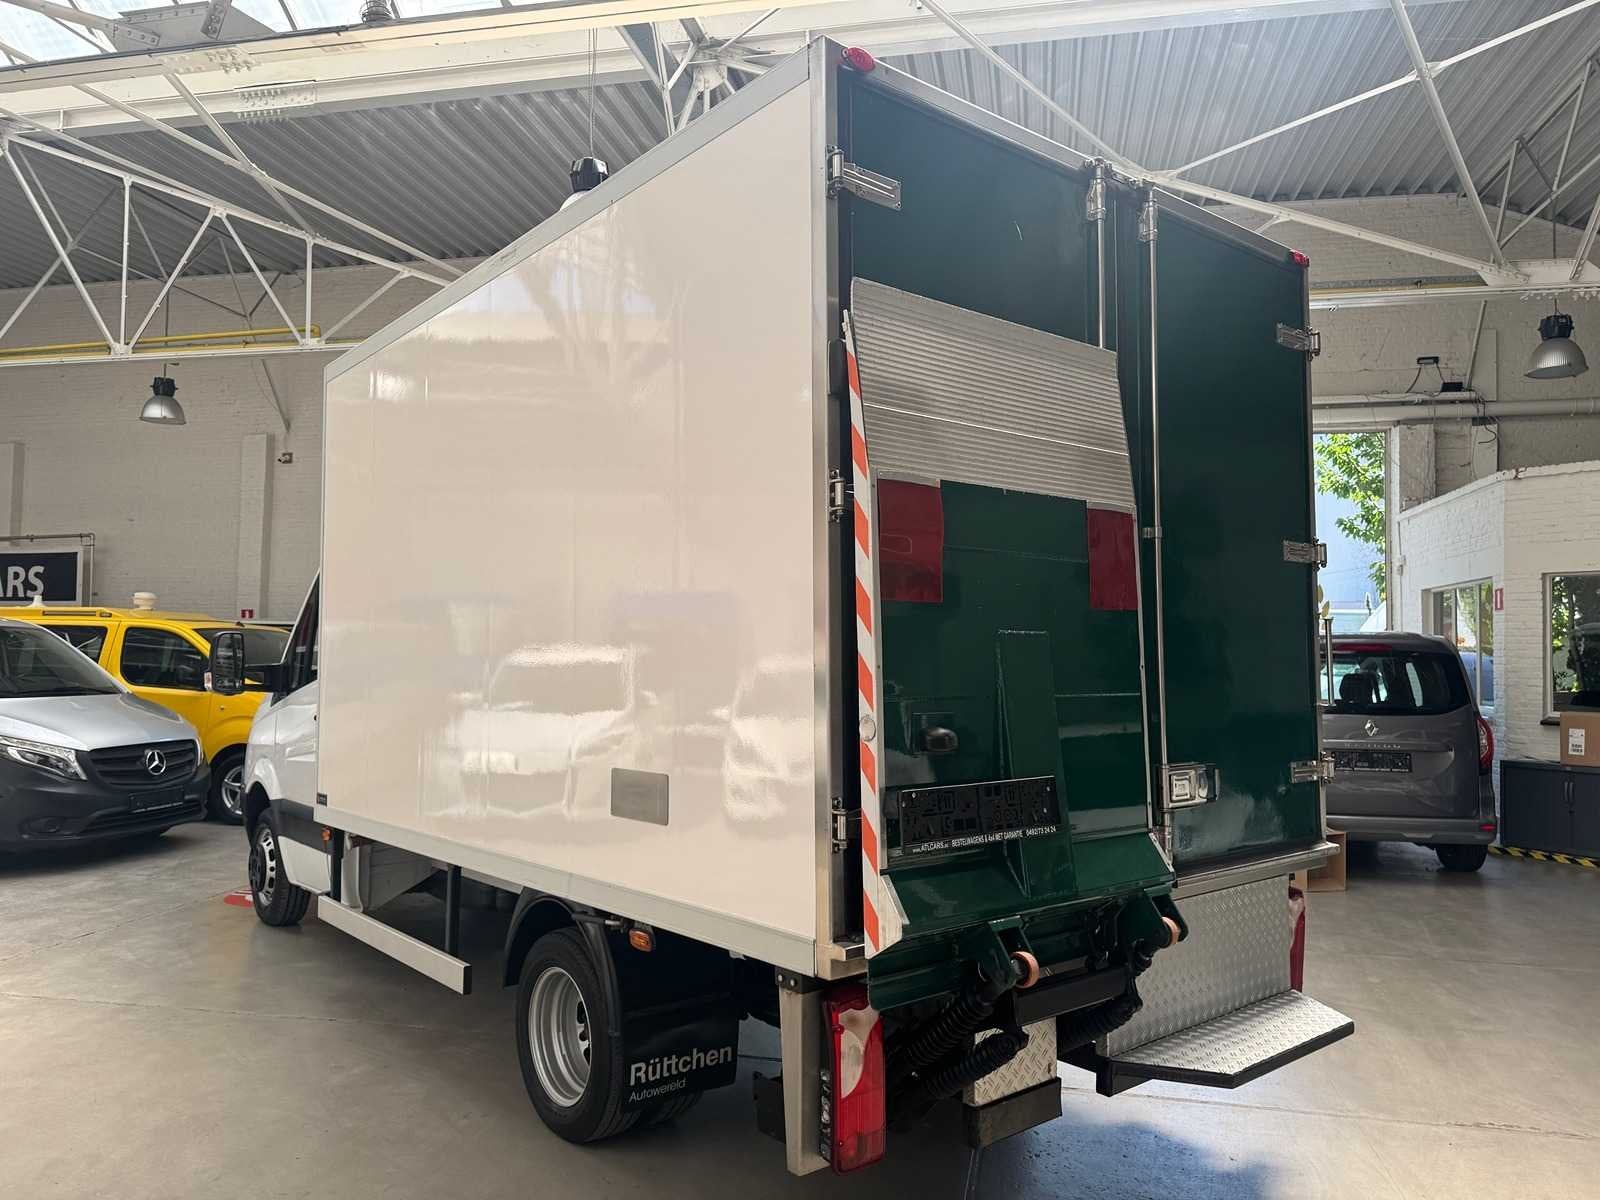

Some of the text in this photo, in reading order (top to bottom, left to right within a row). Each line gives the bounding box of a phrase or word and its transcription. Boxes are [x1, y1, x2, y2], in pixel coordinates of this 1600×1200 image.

[0, 566, 45, 598] RS
[995, 833, 1003, 841] MET
[1003, 830, 1023, 840] GARANTIE
[630, 1046, 732, 1086] Rüttchen
[629, 1079, 686, 1102] Autowereld
